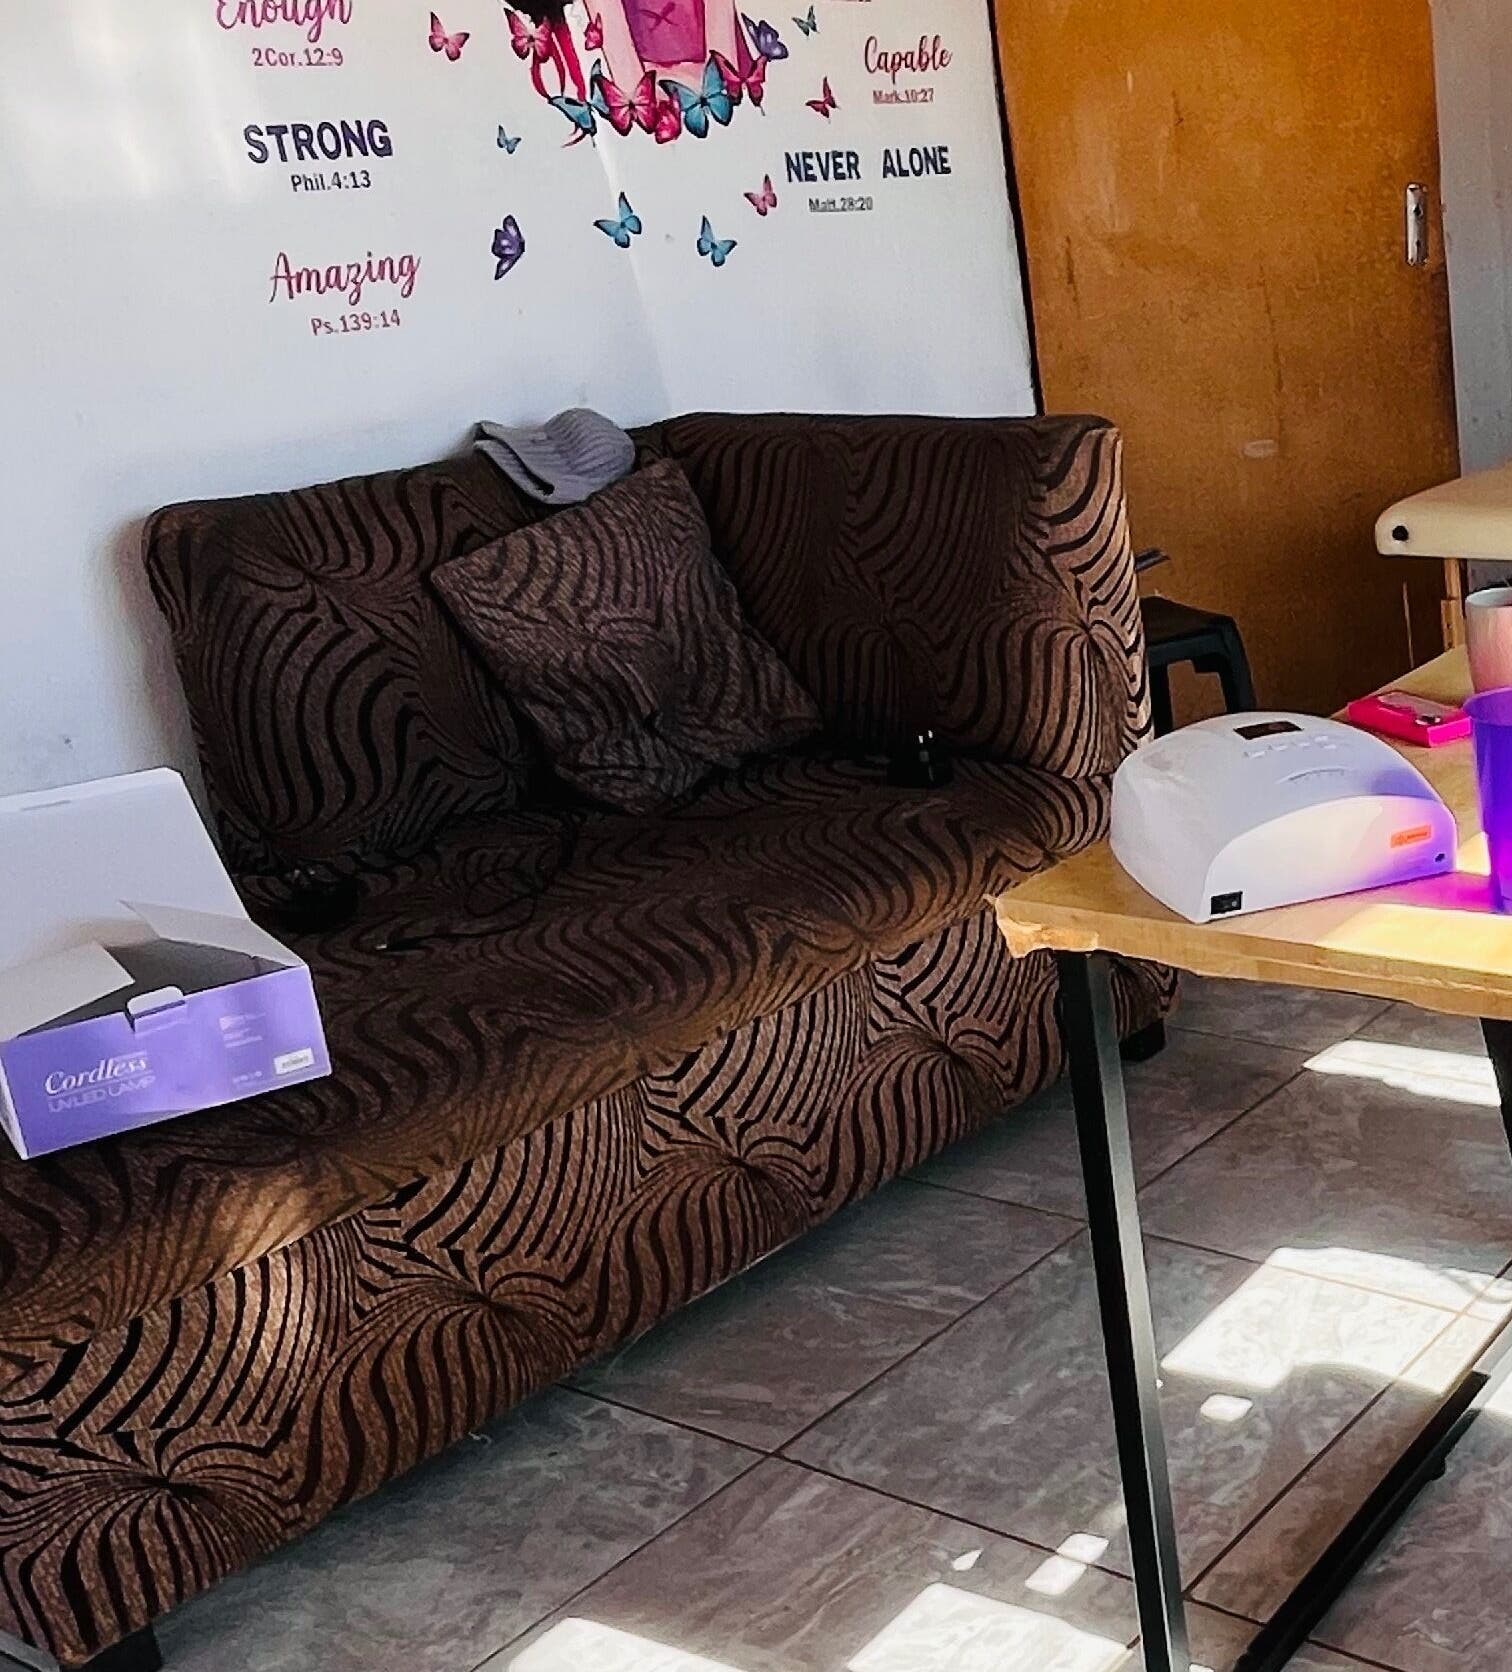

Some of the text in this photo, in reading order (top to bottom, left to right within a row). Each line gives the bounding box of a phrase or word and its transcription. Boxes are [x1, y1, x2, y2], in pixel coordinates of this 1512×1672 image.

[864, 35, 952, 84] Capable
[244, 119, 393, 163] STRONG
[291, 171, 371, 191] Phil.4:13
[784, 145, 952, 183] NEVER ALONE
[269, 251, 421, 306] Amazing
[311, 309, 401, 335] Ps.139:14
[44, 1056, 147, 1096] Cordless
